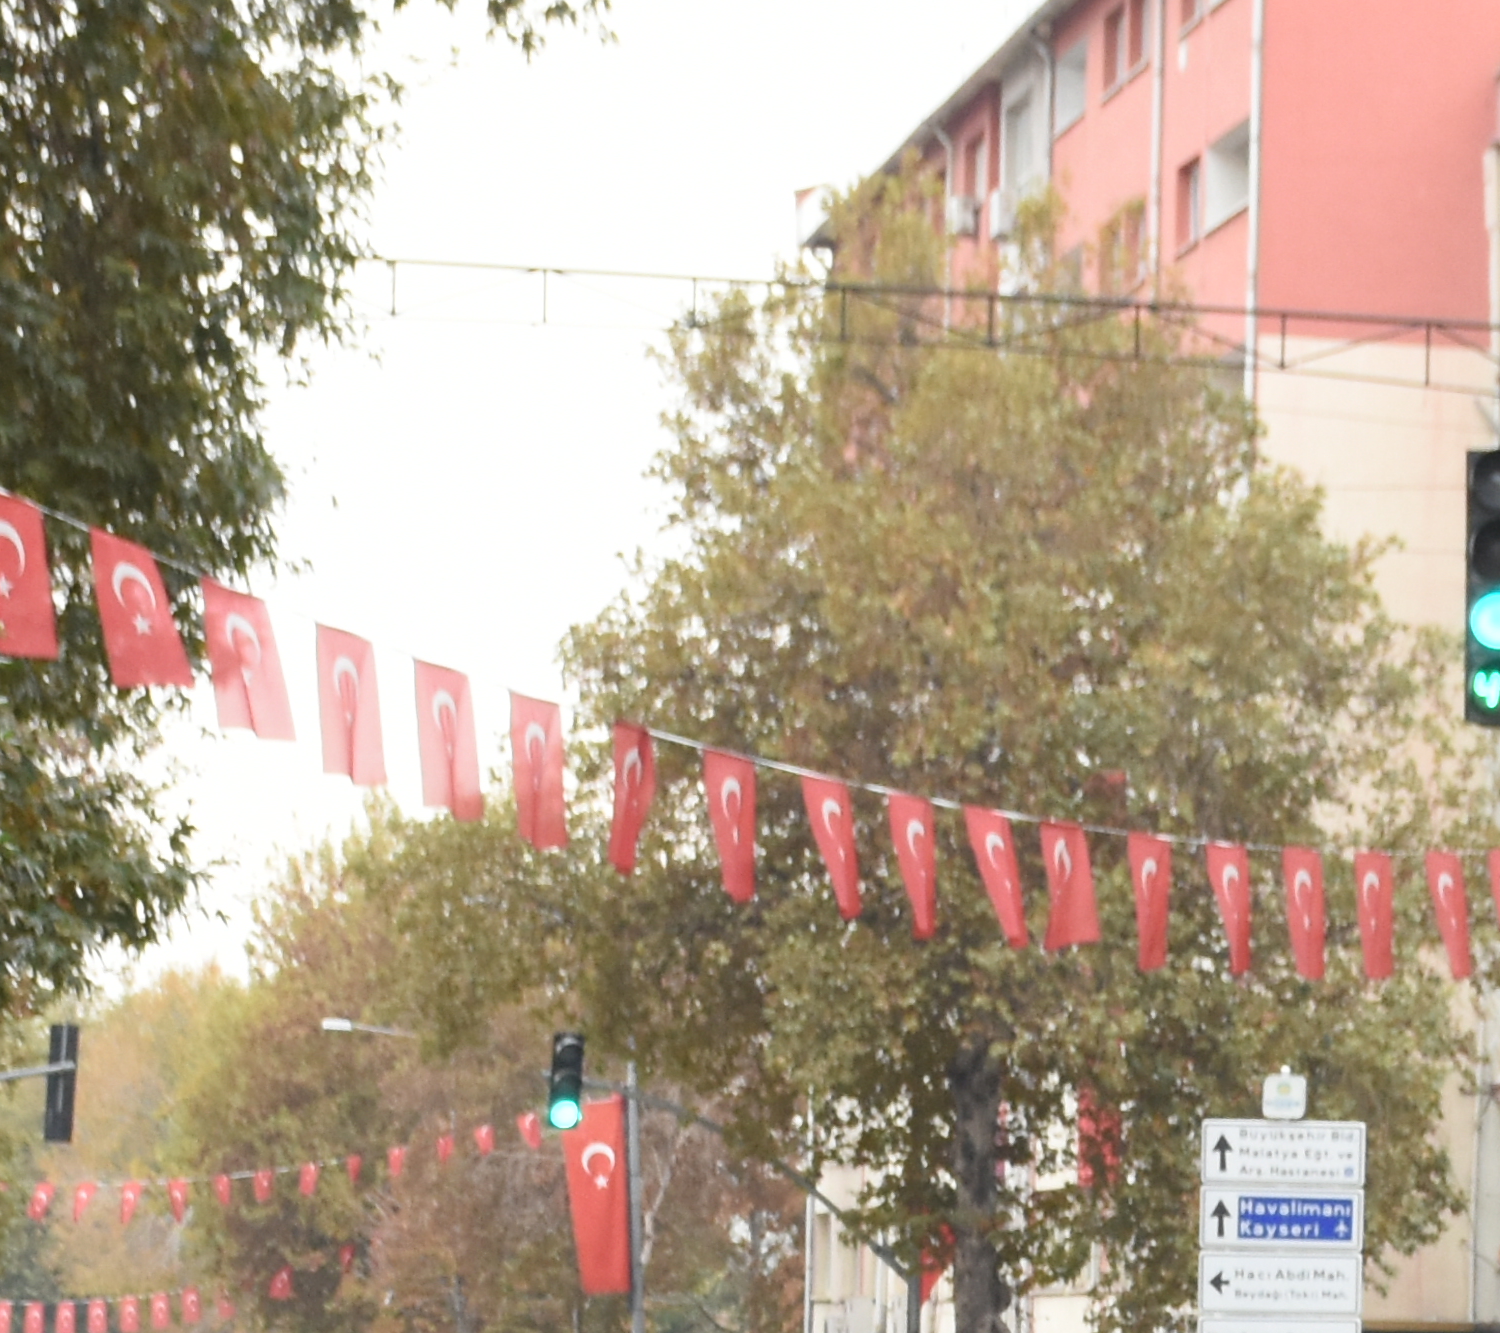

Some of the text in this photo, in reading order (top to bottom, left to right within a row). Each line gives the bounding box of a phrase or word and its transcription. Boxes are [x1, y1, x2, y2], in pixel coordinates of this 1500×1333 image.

[1240, 1199, 1351, 1217] Havalimanı
[1240, 1219, 1320, 1239] Kayseri
[1275, 1269, 1310, 1280] Abdi
